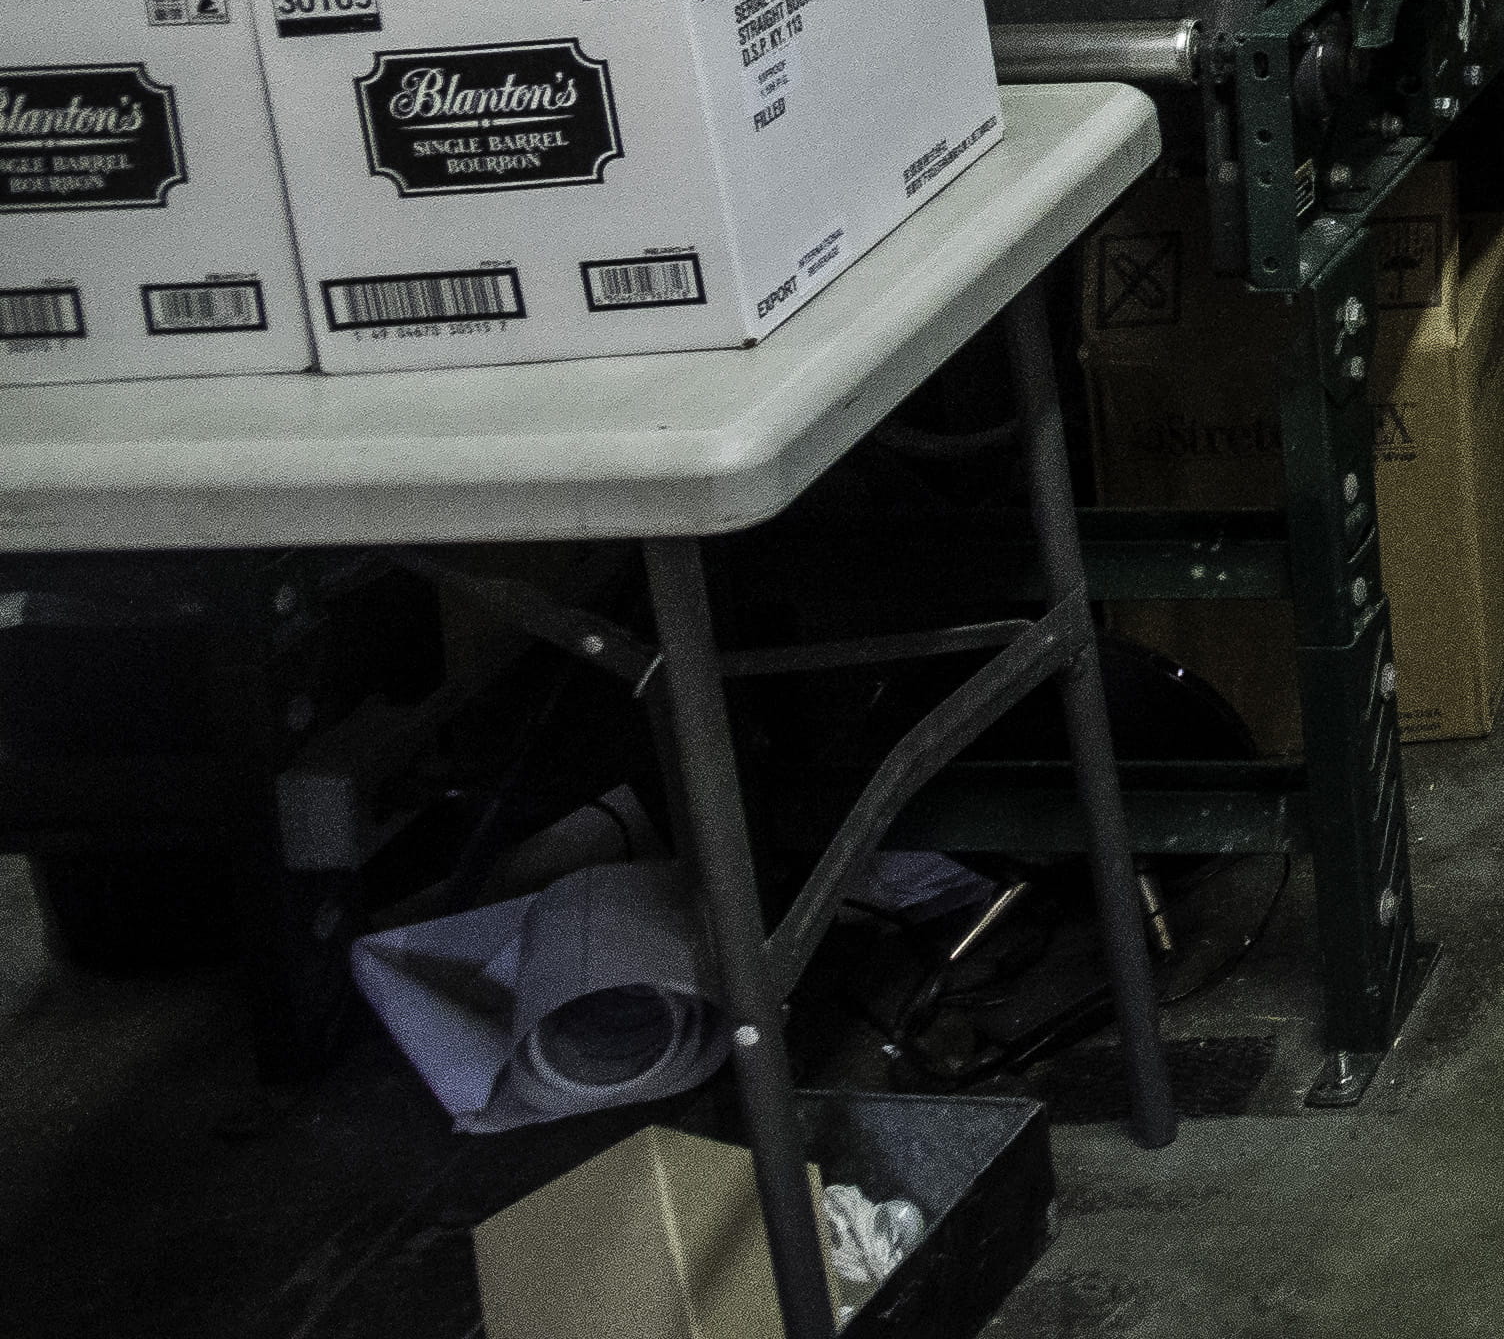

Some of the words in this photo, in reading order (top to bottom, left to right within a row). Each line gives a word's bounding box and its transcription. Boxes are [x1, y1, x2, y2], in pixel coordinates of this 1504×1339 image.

[389, 66, 579, 120] Blanton's
[412, 136, 481, 158] SINGLE
[488, 131, 570, 155] BARREL
[445, 152, 542, 175] BOURBON
[756, 275, 797, 320] EXPORT
